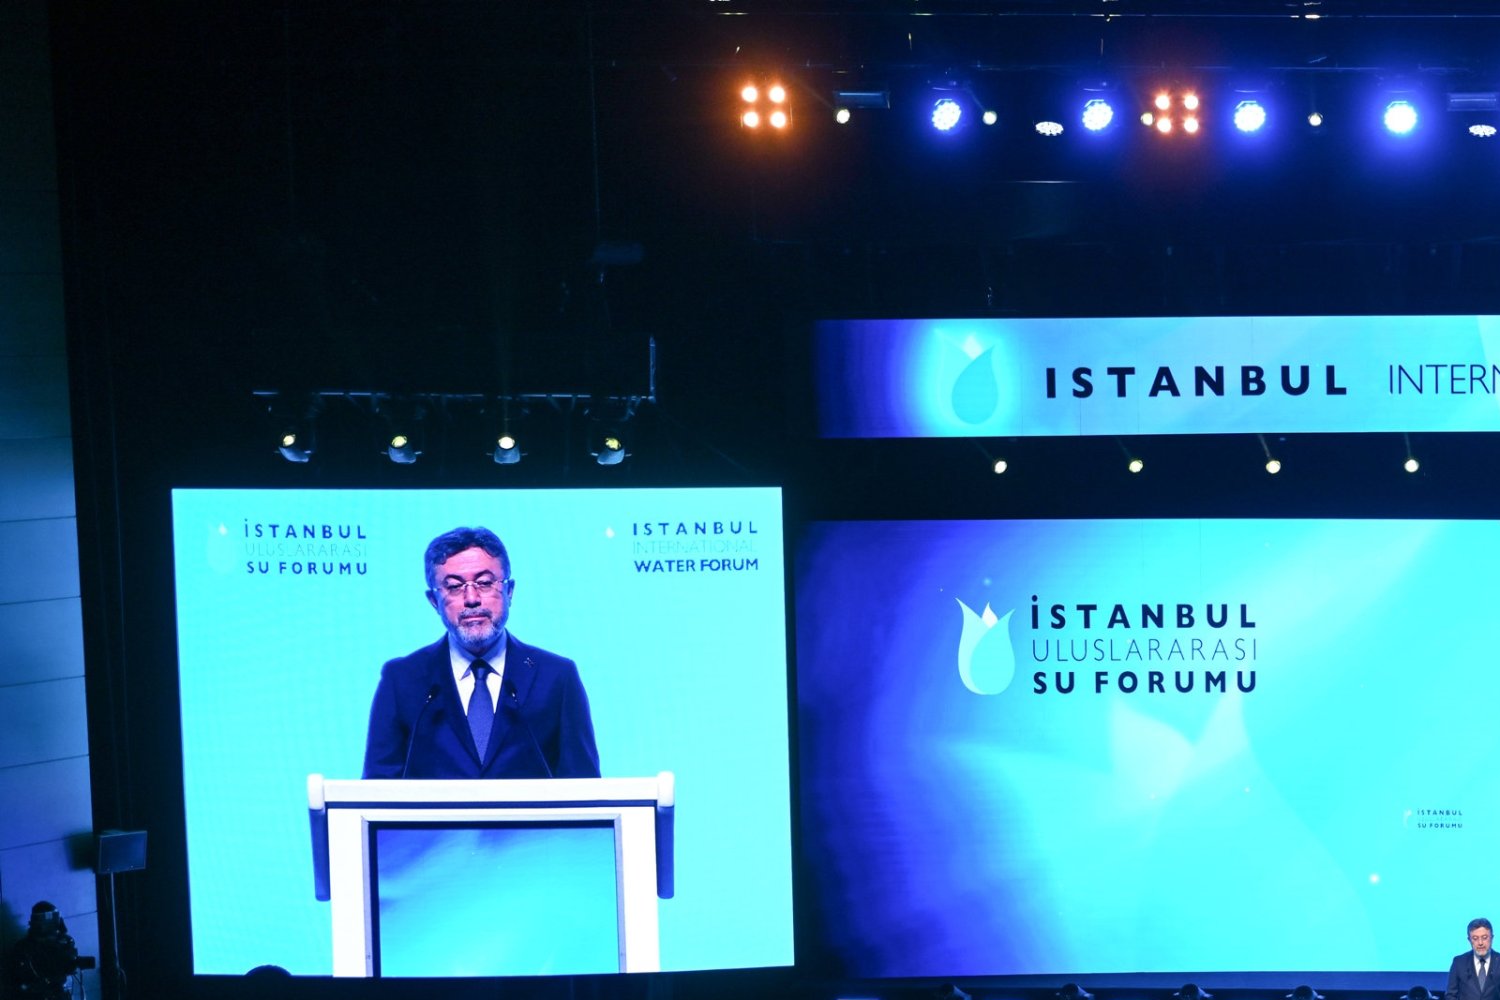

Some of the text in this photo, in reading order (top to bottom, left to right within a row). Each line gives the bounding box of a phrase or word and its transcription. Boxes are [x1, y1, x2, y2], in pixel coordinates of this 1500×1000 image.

[1045, 364, 1348, 399] ISTANBUL
[244, 518, 367, 539] İSTANBUL
[632, 521, 758, 536] ISTANBUL
[246, 561, 367, 575] SU FORUMU
[633, 558, 759, 572] WATER FORUM
[1031, 595, 1257, 630] İSTANBUL
[1032, 638, 1257, 662] ULUSLARARASI
[1033, 670, 1257, 695] SU FORUMU
